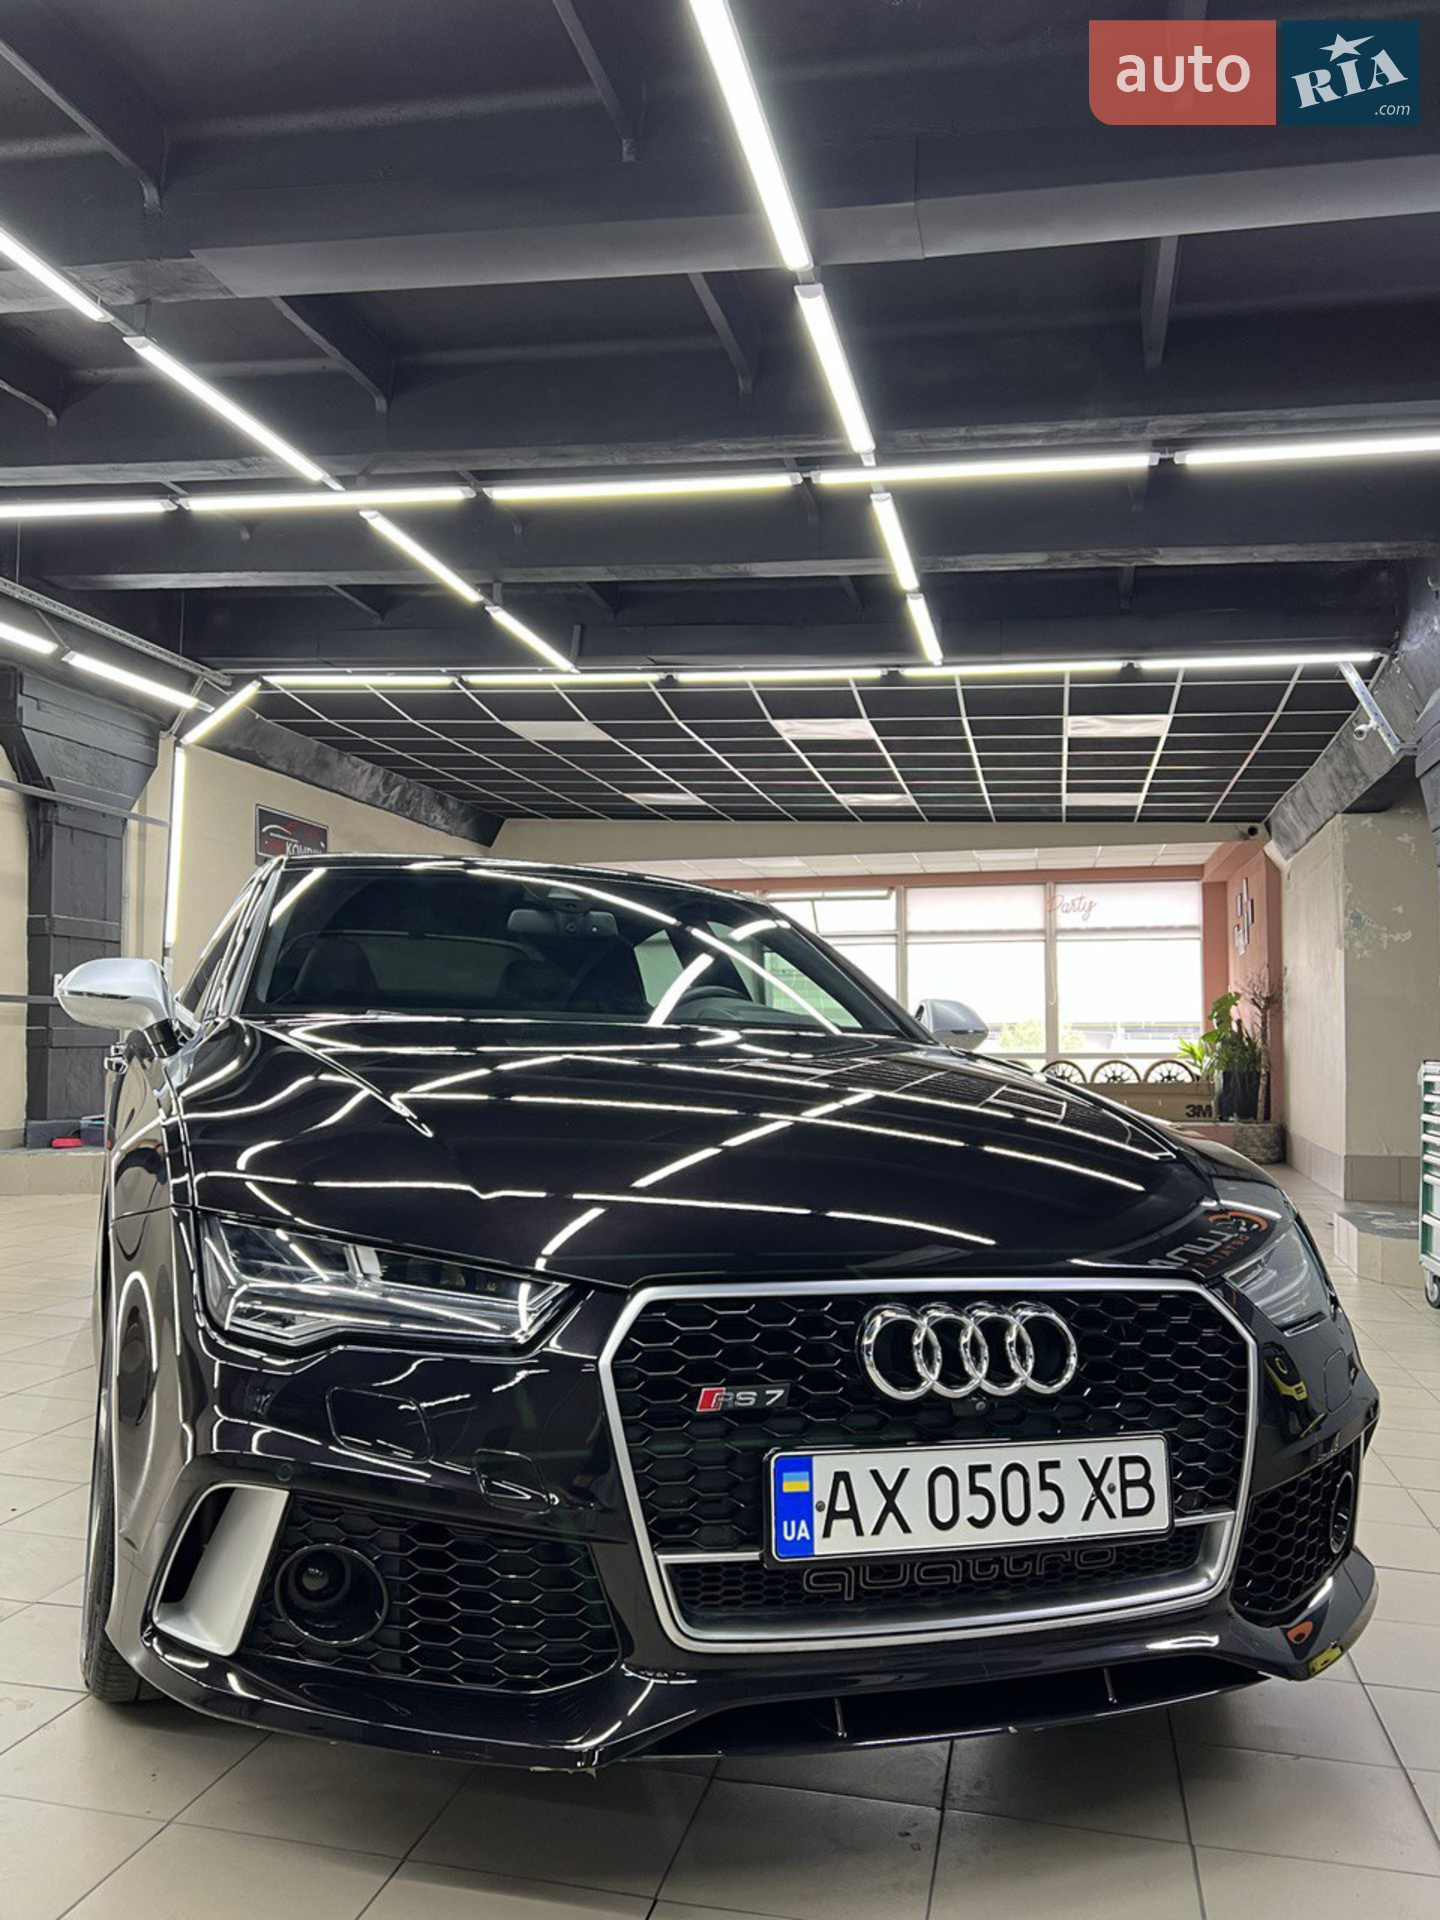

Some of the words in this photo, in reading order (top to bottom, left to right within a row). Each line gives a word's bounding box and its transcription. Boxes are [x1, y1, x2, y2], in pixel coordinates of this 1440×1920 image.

[1045, 893, 1098, 921] Party
[1185, 1104, 1212, 1118] 3M
[821, 1467, 913, 1539] AX
[927, 1460, 1066, 1532] 0505
[1078, 1455, 1156, 1522] XB
[783, 1520, 811, 1542] UA
[803, 1546, 1116, 1602] quattro
